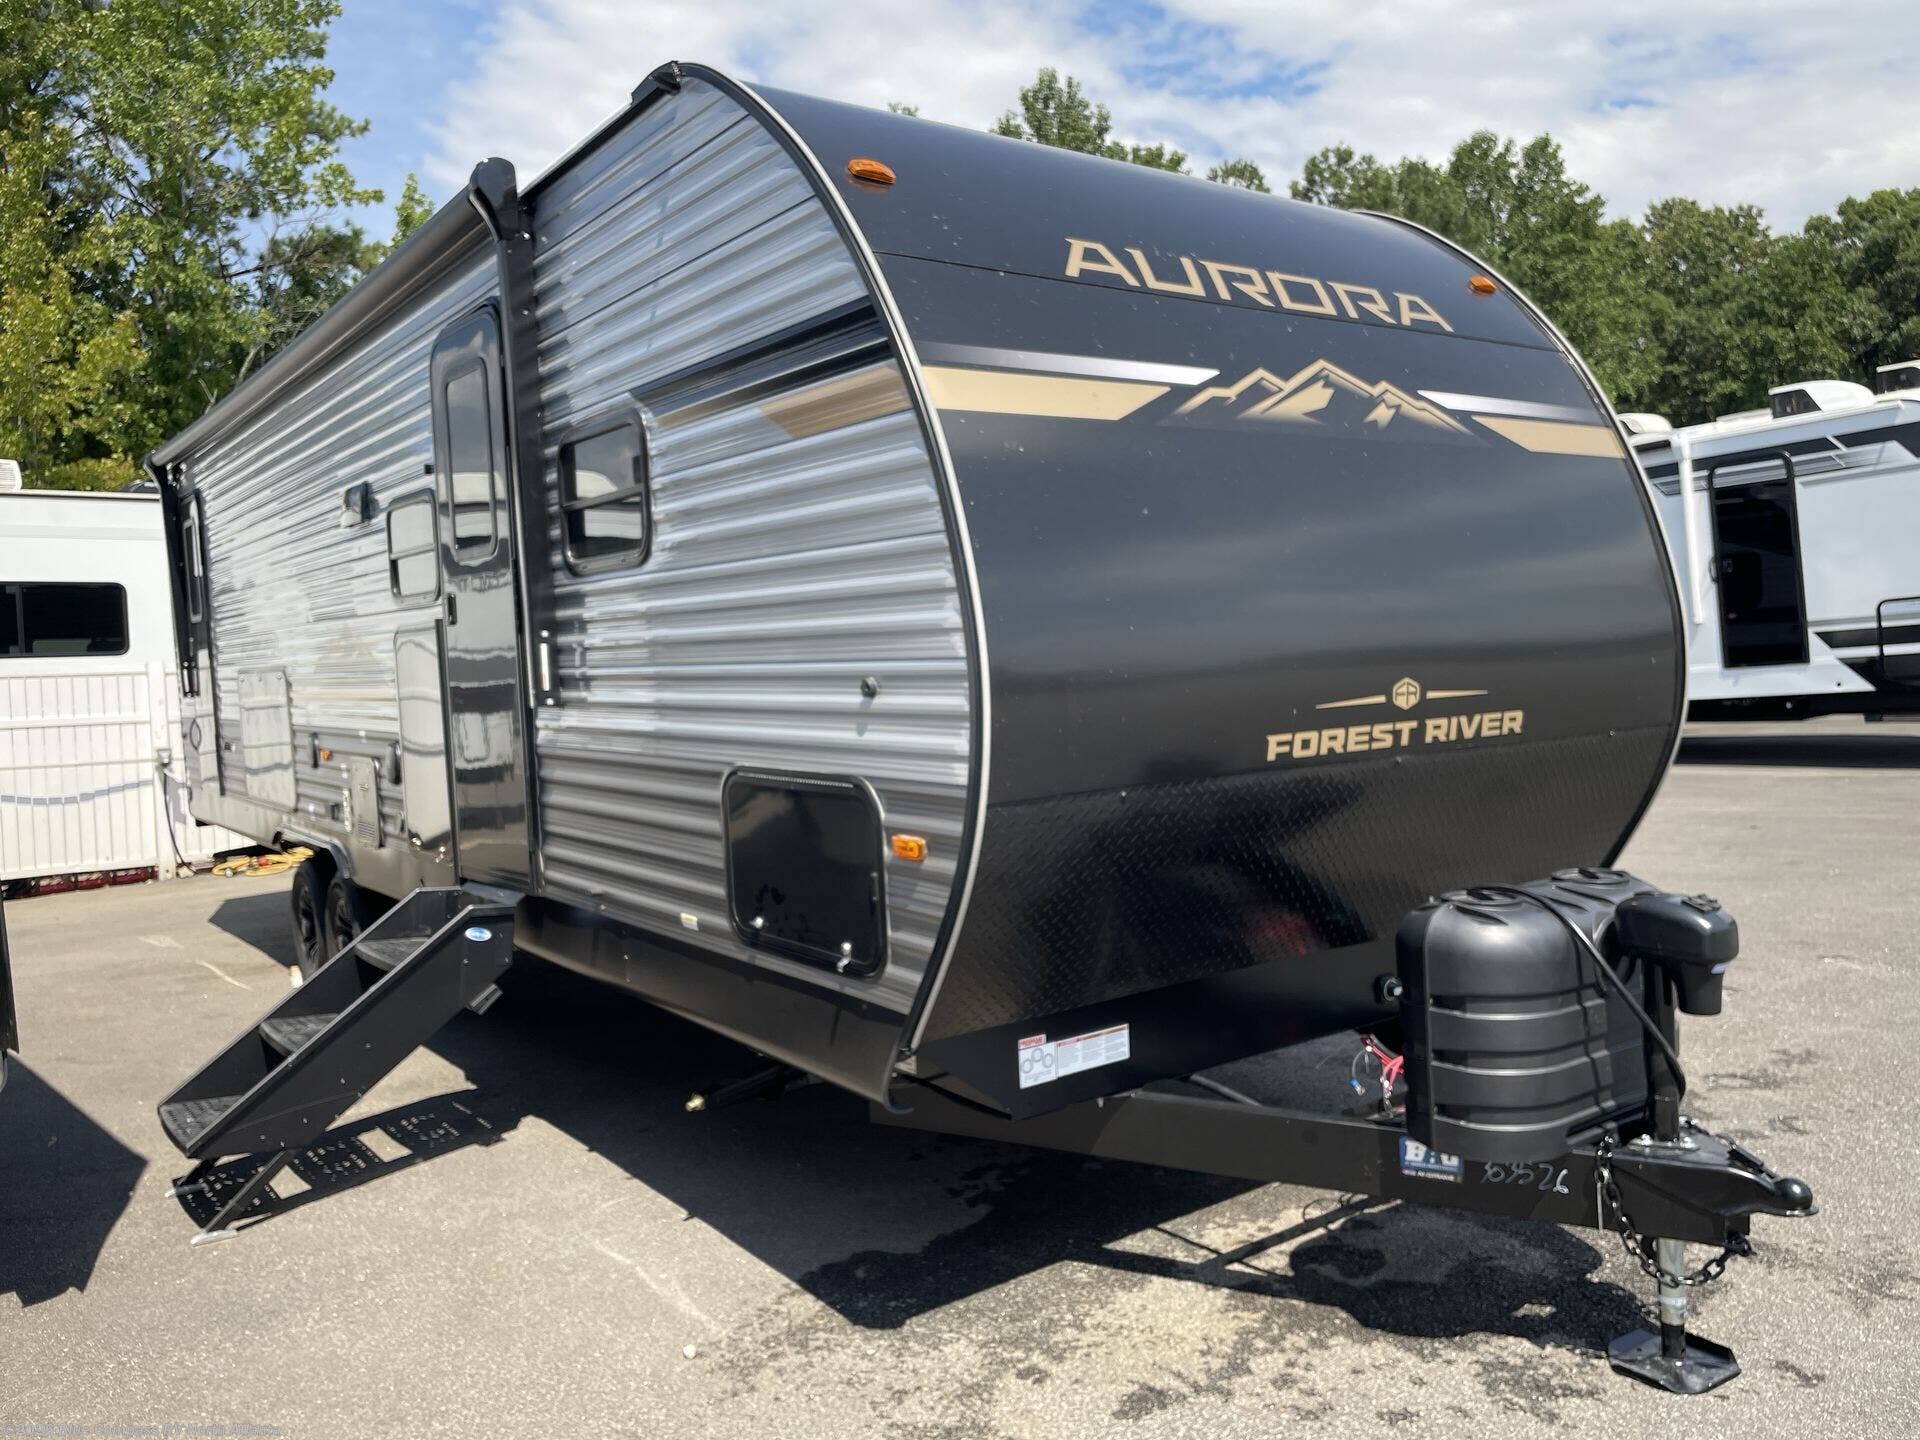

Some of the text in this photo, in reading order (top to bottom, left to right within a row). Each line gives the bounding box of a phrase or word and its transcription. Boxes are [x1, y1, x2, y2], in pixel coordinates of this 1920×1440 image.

[1064, 237, 1455, 333] AURORA
[1266, 709, 1524, 762] FOREST RIVER
